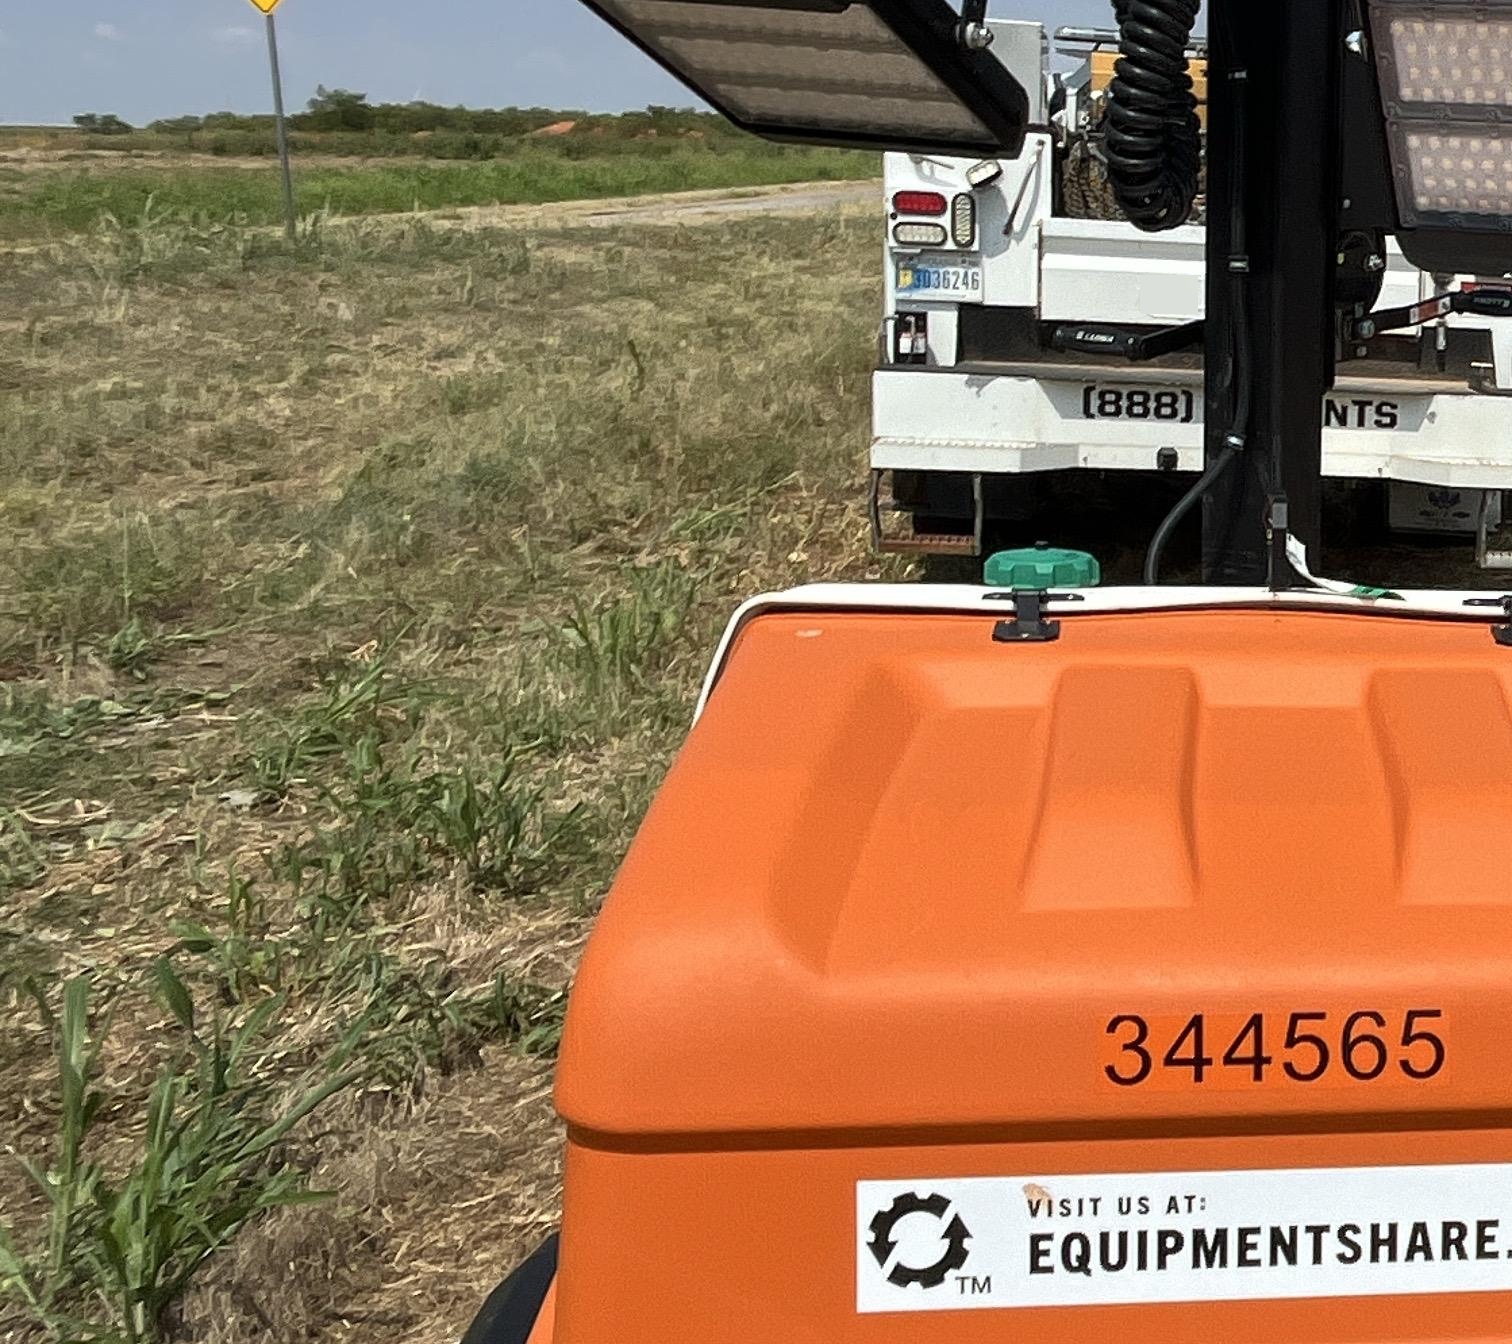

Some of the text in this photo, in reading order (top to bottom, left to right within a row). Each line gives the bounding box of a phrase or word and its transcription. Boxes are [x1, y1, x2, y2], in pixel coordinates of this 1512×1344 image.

[1081, 385, 1195, 425] (888)
[1103, 1008, 1446, 1087] 344565
[1026, 1193, 1208, 1220] VISIT US AT:
[954, 1276, 992, 1296] TM
